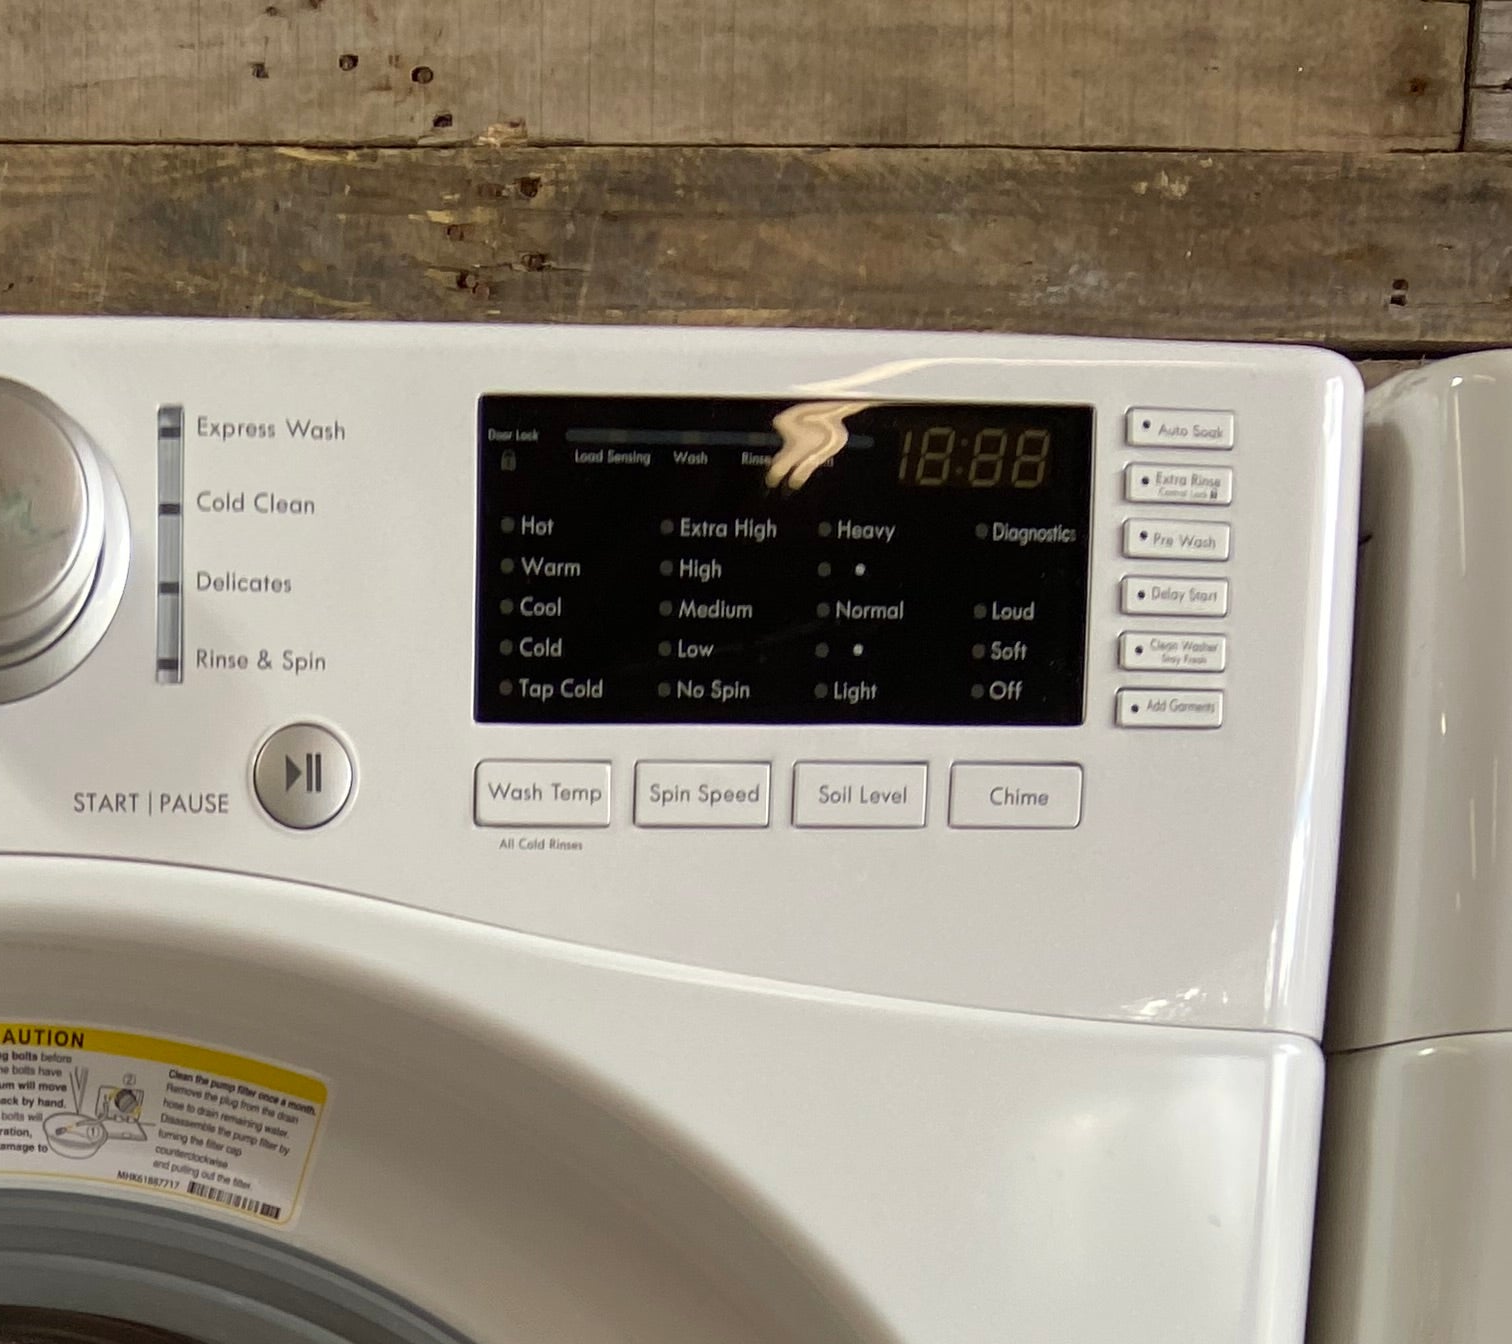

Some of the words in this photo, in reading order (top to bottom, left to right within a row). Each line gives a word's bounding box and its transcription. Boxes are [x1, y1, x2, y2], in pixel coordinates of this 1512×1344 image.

[196, 415, 276, 440] Express
[285, 418, 346, 441] Wash
[1157, 423, 1188, 438] Auto
[574, 449, 603, 464] Load
[672, 450, 709, 465] Wash
[1155, 471, 1187, 487] Extra
[1190, 472, 1221, 488] Rinse
[196, 491, 245, 513] Cold
[253, 493, 316, 515] Clean
[520, 515, 554, 537] Hot
[679, 517, 728, 539] Extra
[734, 518, 777, 542] High
[837, 519, 896, 543] Heavy
[992, 521, 1077, 547] Diagnostics
[1153, 533, 1174, 547] Pre
[1179, 534, 1216, 550] Wash
[520, 556, 581, 577] Warm
[679, 558, 722, 583] High
[196, 571, 292, 593] Delicates
[1150, 586, 1186, 604] Delay
[519, 596, 562, 617] Cool
[678, 598, 753, 619] Medium
[835, 600, 904, 620] Normal
[991, 601, 1035, 621] Loud
[519, 636, 563, 657] Cold
[677, 639, 714, 658] Low
[990, 640, 1028, 661] Soft
[196, 650, 248, 670] Rinse
[256, 651, 273, 671] &
[281, 650, 327, 675] Spin
[518, 678, 554, 702] Tap
[560, 678, 604, 699] Cold
[676, 679, 705, 699] No
[710, 680, 750, 703] Spin
[833, 681, 878, 705] Light
[989, 680, 1023, 701] Off
[1146, 698, 1166, 713] Add
[72, 792, 140, 813] START
[160, 793, 230, 815] PAUSE
[488, 782, 543, 803] Wash
[551, 782, 603, 807] Temp
[649, 783, 691, 807] Spin
[698, 784, 760, 807] Speed
[818, 784, 853, 805] Soil
[860, 785, 908, 805] Level
[989, 786, 1049, 807] Chime
[499, 838, 515, 851] All
[518, 838, 545, 851] Cold
[549, 839, 583, 851] Rinses
